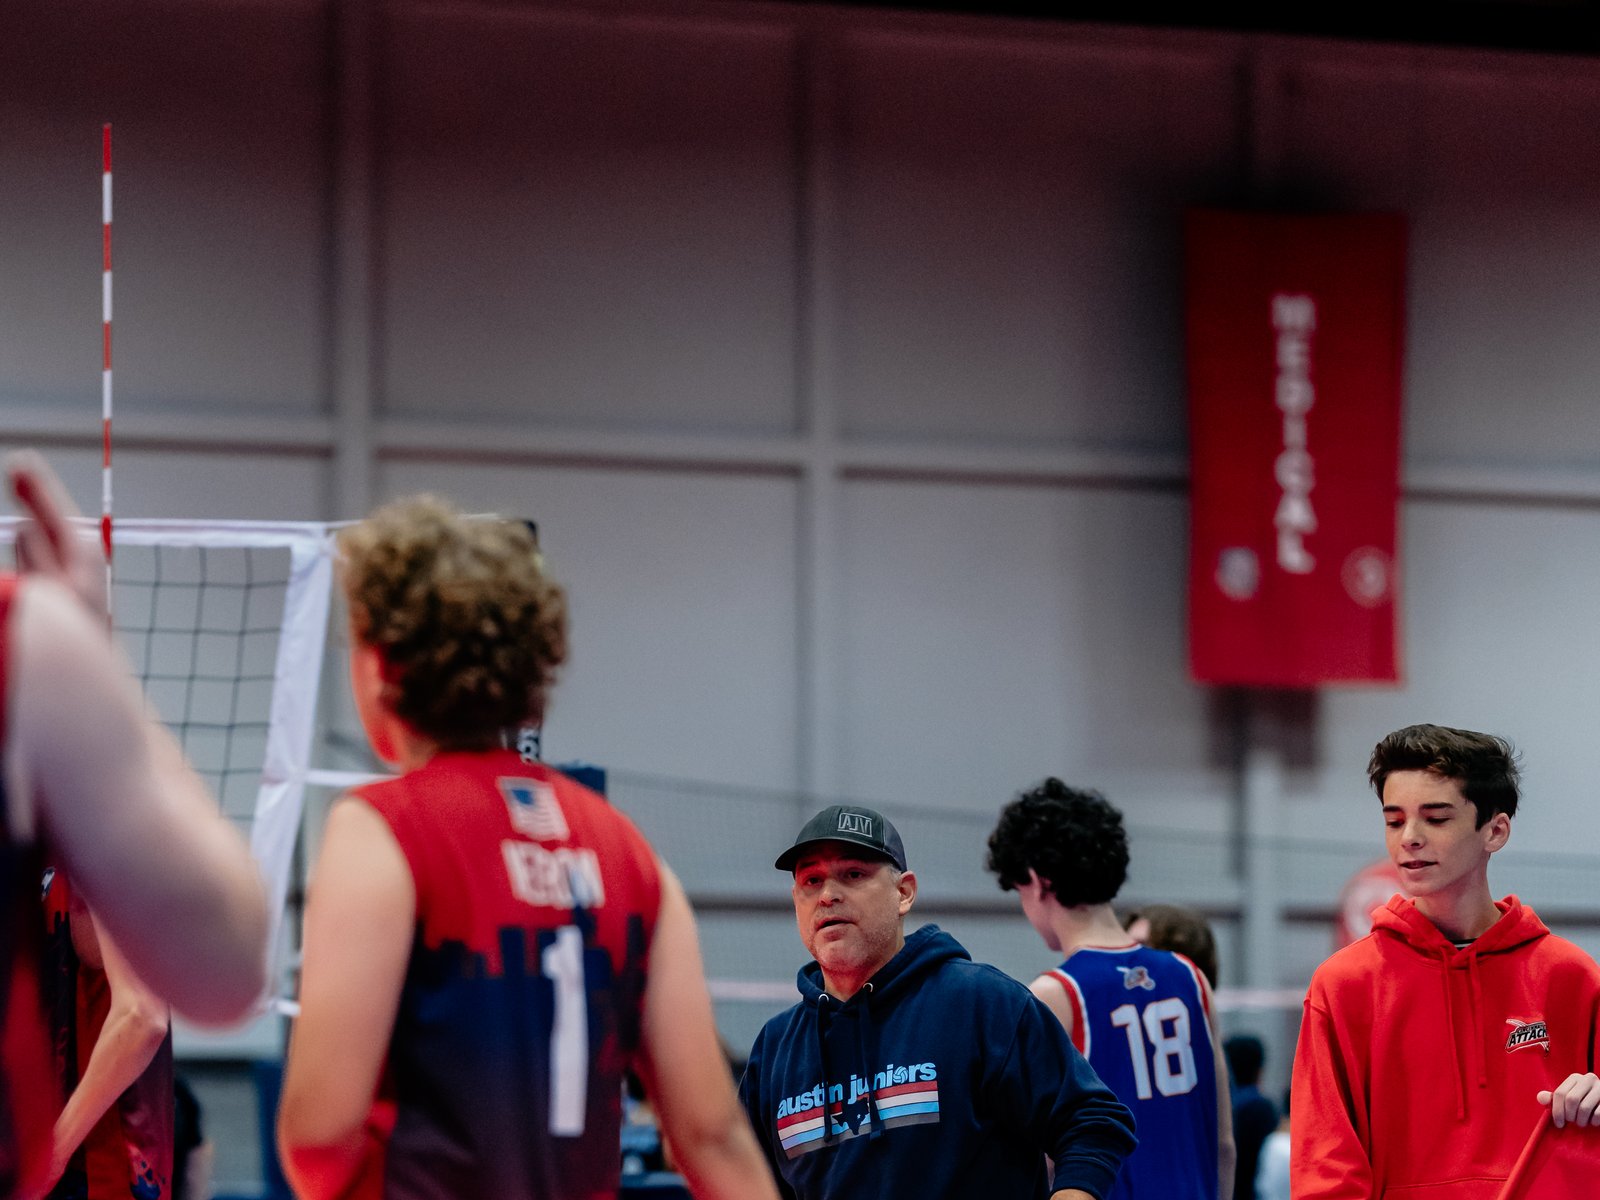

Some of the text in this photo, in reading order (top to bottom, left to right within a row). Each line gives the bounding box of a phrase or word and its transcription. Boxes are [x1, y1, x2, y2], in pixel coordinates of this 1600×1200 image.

[1271, 295, 1317, 574] MEDICAL
[541, 925, 588, 1137] 1
[777, 1082, 843, 1119] austin
[1111, 997, 1198, 1100] 18
